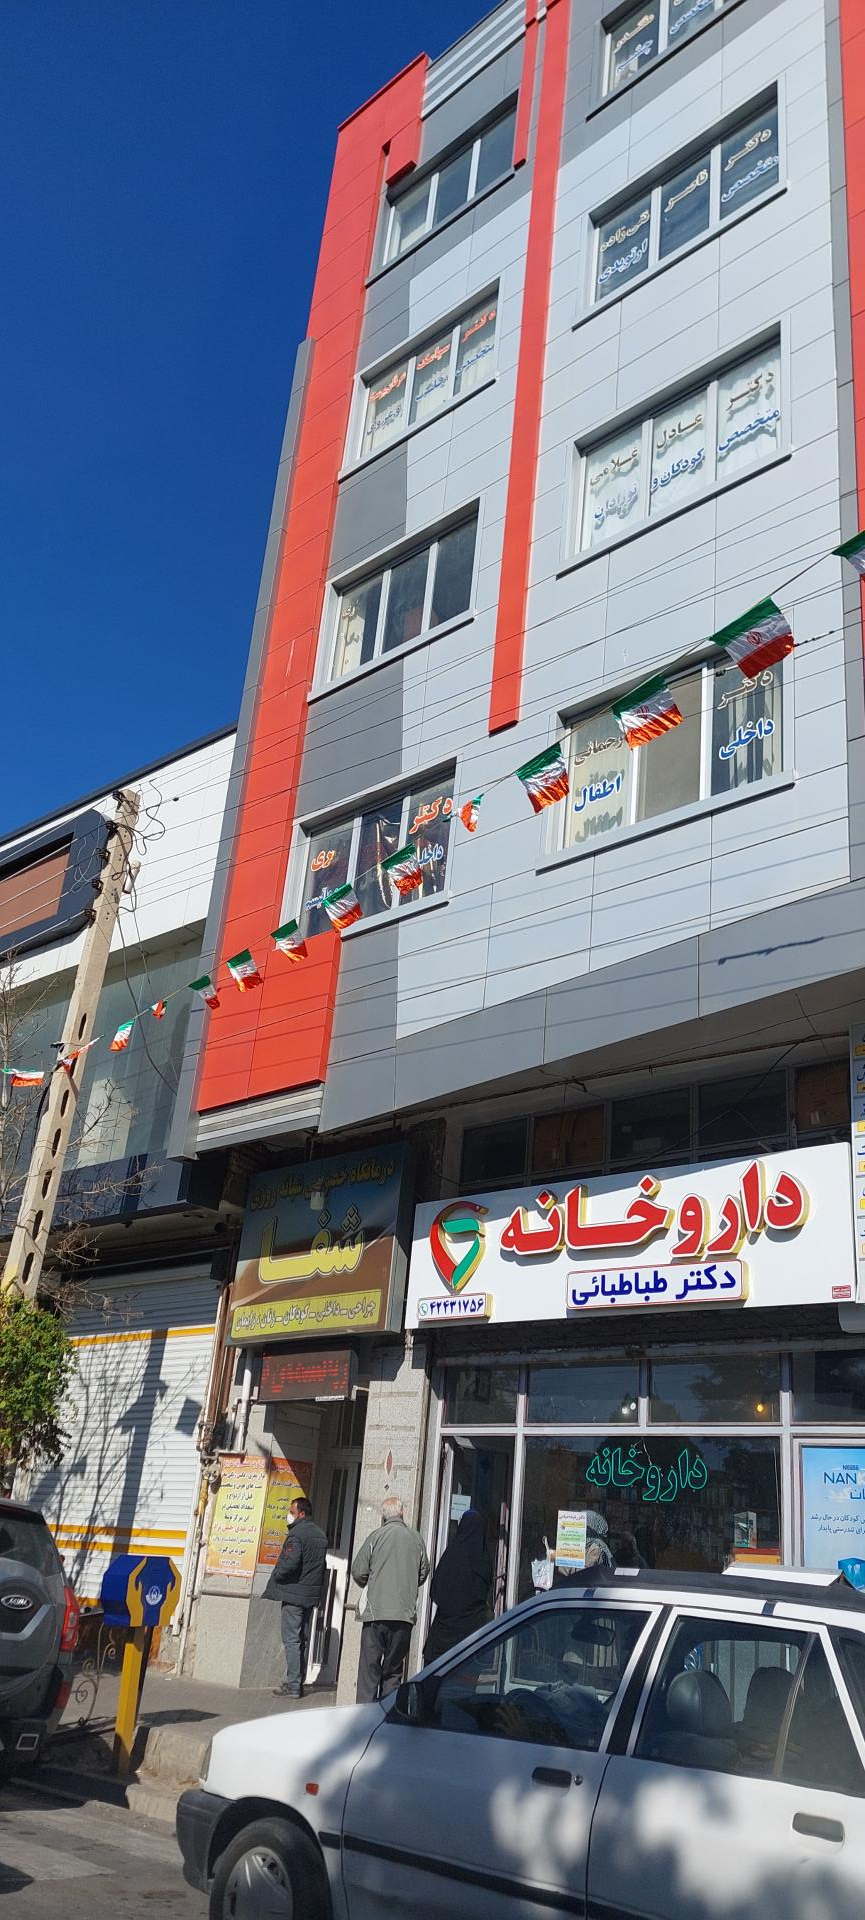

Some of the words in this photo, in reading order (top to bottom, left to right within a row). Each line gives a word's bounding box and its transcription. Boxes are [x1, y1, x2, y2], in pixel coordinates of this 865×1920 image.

[724, 129, 772, 171] دکتر
[721, 156, 779, 203] متخصص
[461, 309, 496, 344] دکتر
[726, 370, 774, 411] دکتر
[656, 413, 703, 449] عادل
[718, 408, 780, 452] متخصص
[660, 448, 706, 487] کودکان
[717, 670, 773, 709] دکتر
[719, 718, 775, 760] داخلی
[573, 773, 622, 814] اطفال
[409, 796, 454, 835] دکتر
[352, 1156, 395, 1185] درمانگاه
[500, 1160, 806, 1257] داروخانه
[259, 1203, 365, 1285] شفا
[571, 1270, 668, 1305] طباطبائی
[675, 1264, 736, 1300] دکتر
[282, 1303, 310, 1325] کودکان
[316, 1300, 340, 1322] داخلی
[347, 1297, 376, 1319] جراحی
[429, 1298, 484, 1316] ۴۲۴۳۱۷۵۶
[585, 1446, 708, 1502] داروخانه
[823, 1471, 858, 1485] NAN
